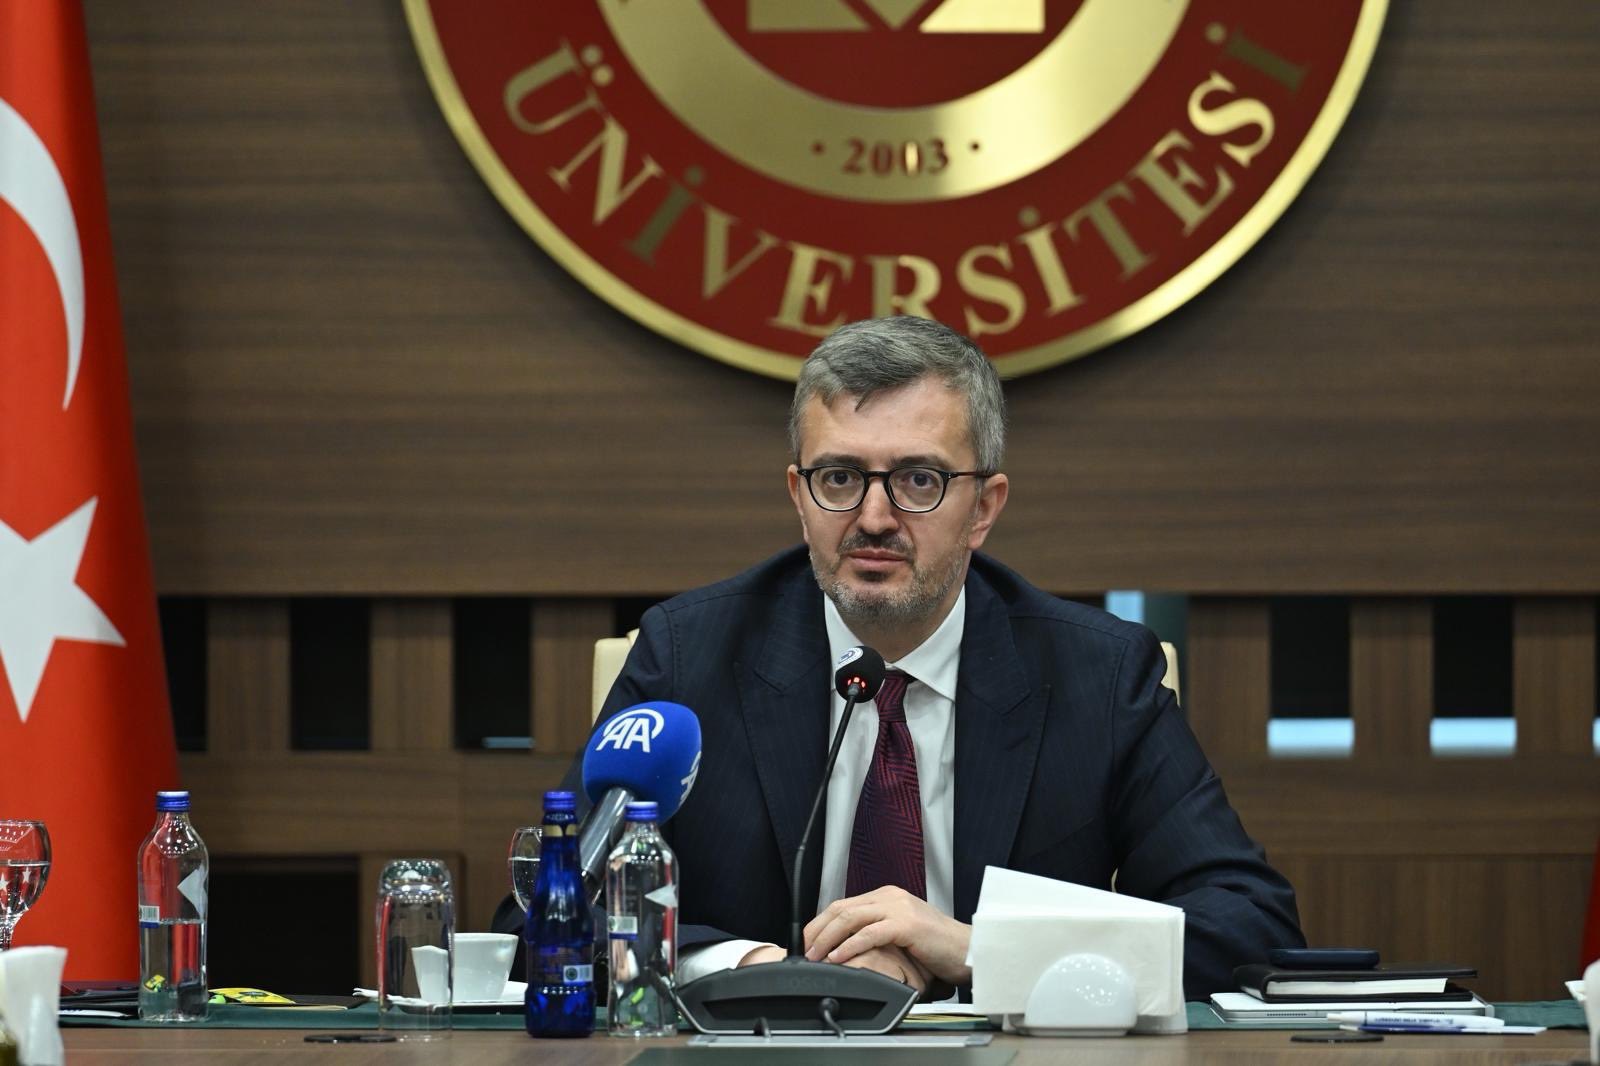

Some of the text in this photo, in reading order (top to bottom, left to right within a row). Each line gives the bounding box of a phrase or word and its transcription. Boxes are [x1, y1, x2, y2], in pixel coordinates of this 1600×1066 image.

[842, 136, 949, 176] 2003
[503, 21, 1311, 337] ÜNİVERSİTESİ
[595, 710, 661, 753] AA
